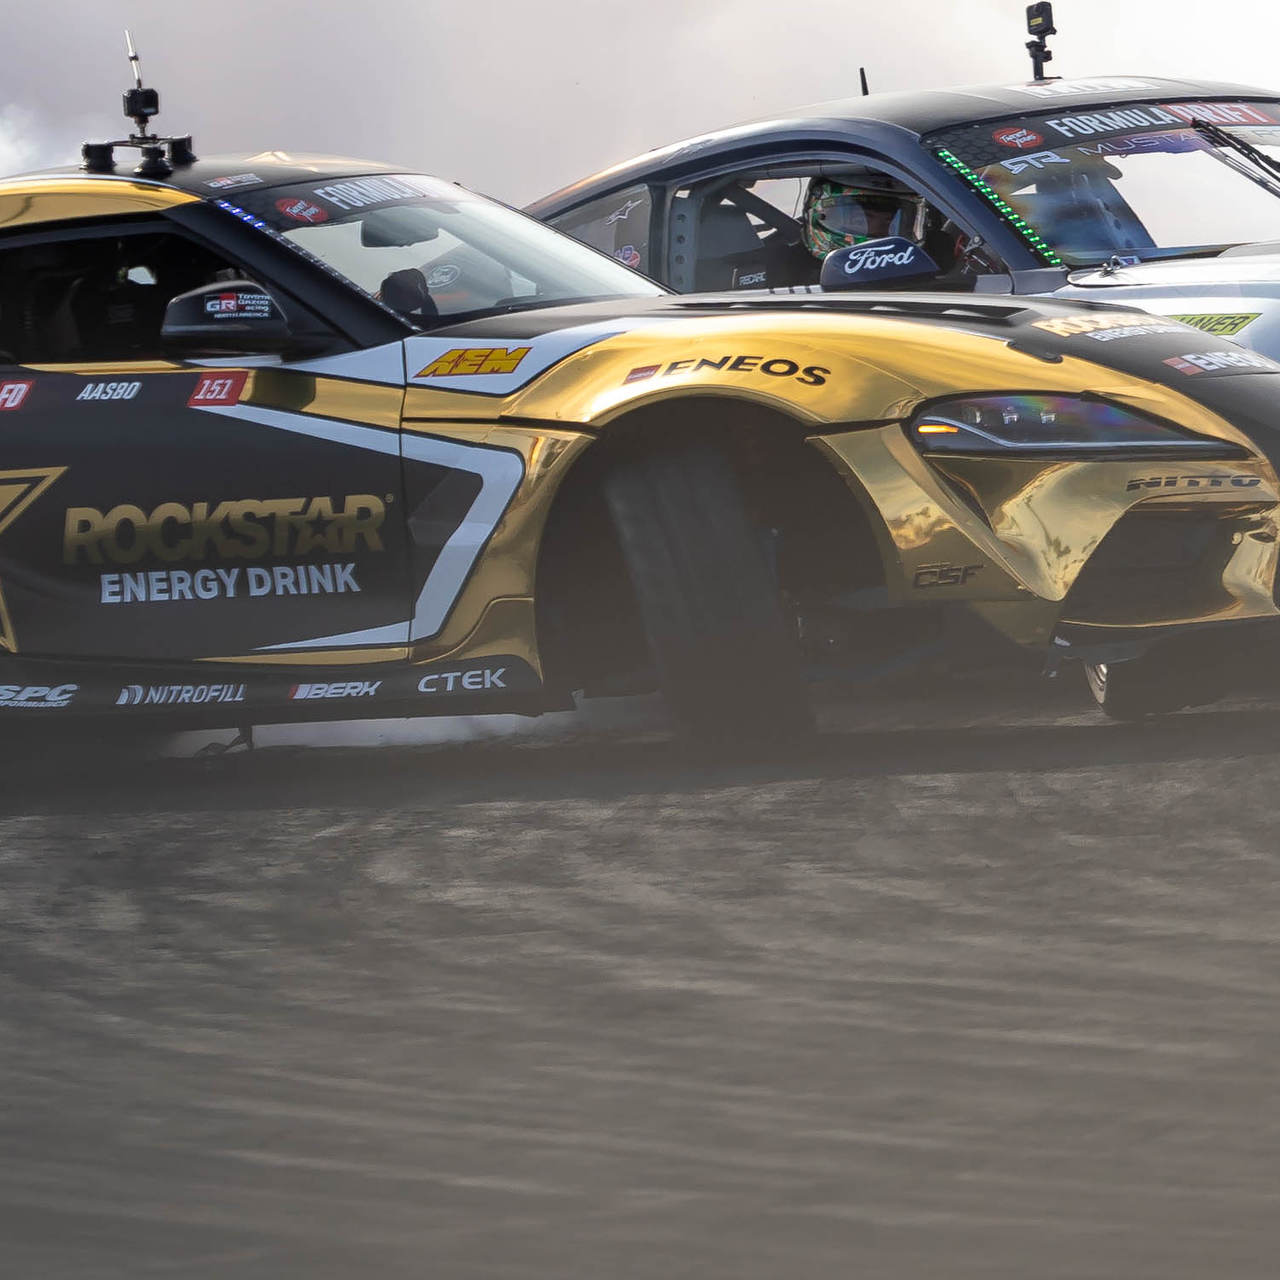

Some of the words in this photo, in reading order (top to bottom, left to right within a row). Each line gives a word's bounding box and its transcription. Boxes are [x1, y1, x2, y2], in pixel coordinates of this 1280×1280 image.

[1045, 107, 1184, 137] FORMULA
[1168, 103, 1271, 124] DRIFT
[1077, 127, 1247, 156] MUSTA
[844, 244, 915, 274] Ford
[206, 300, 235, 312] GR
[419, 347, 531, 377] AEM
[662, 355, 832, 387] ENEOS
[76, 382, 142, 400] AASBO
[194, 379, 234, 400] 151
[100, 568, 239, 604] ENERGY
[248, 563, 361, 598] DRINK
[309, 680, 383, 699] BERK
[417, 668, 507, 693] CTEK
[145, 684, 248, 705] NITROFILL
